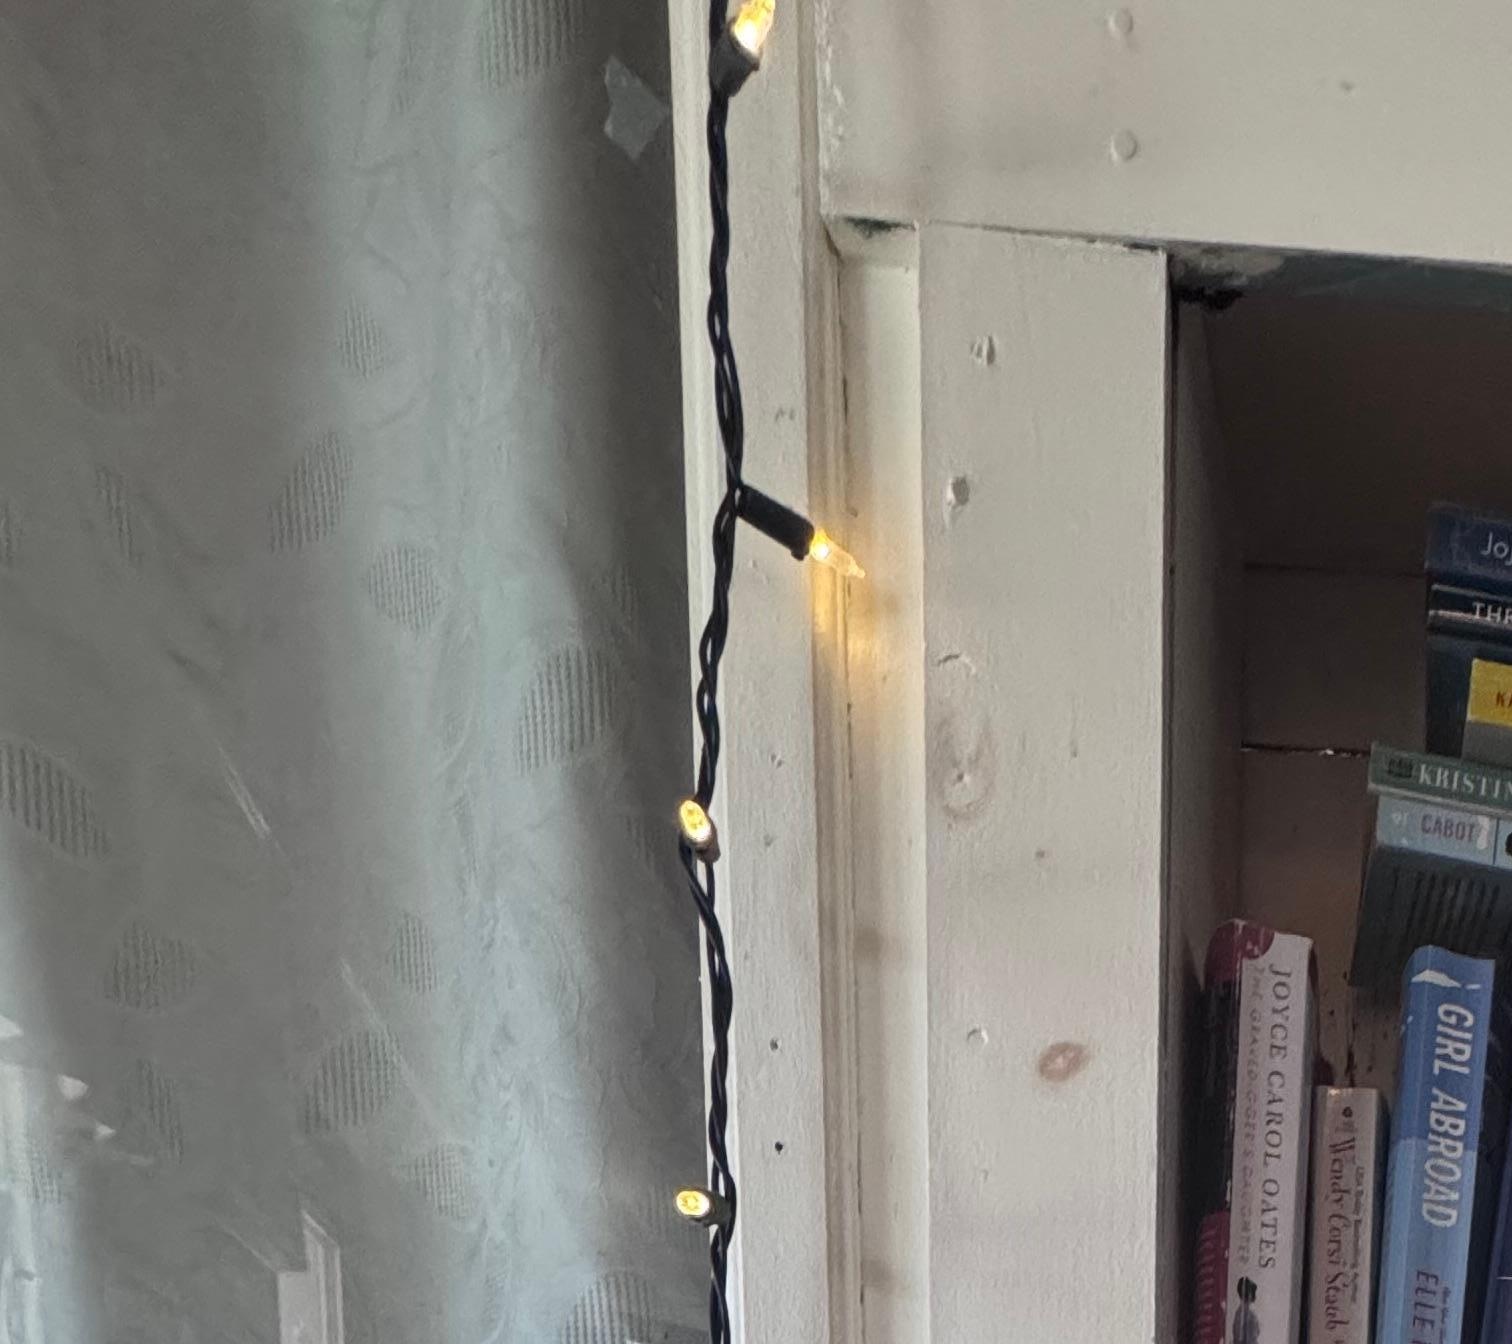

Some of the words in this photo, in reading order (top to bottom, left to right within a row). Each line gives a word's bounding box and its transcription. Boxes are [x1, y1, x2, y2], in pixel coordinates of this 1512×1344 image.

[1421, 813, 1475, 842] CABOT
[1268, 963, 1292, 1060] JOYCE
[1433, 1002, 1475, 1075] GIRL
[1263, 1070, 1286, 1167] CAROL
[1326, 1136, 1355, 1204] Wendy
[1421, 1086, 1469, 1229] ABROAD
[1258, 1178, 1281, 1270] OATES
[1326, 1213, 1350, 1265] Corsi
[1324, 1271, 1350, 1332] Staub
[1412, 1269, 1440, 1329] ELLE
